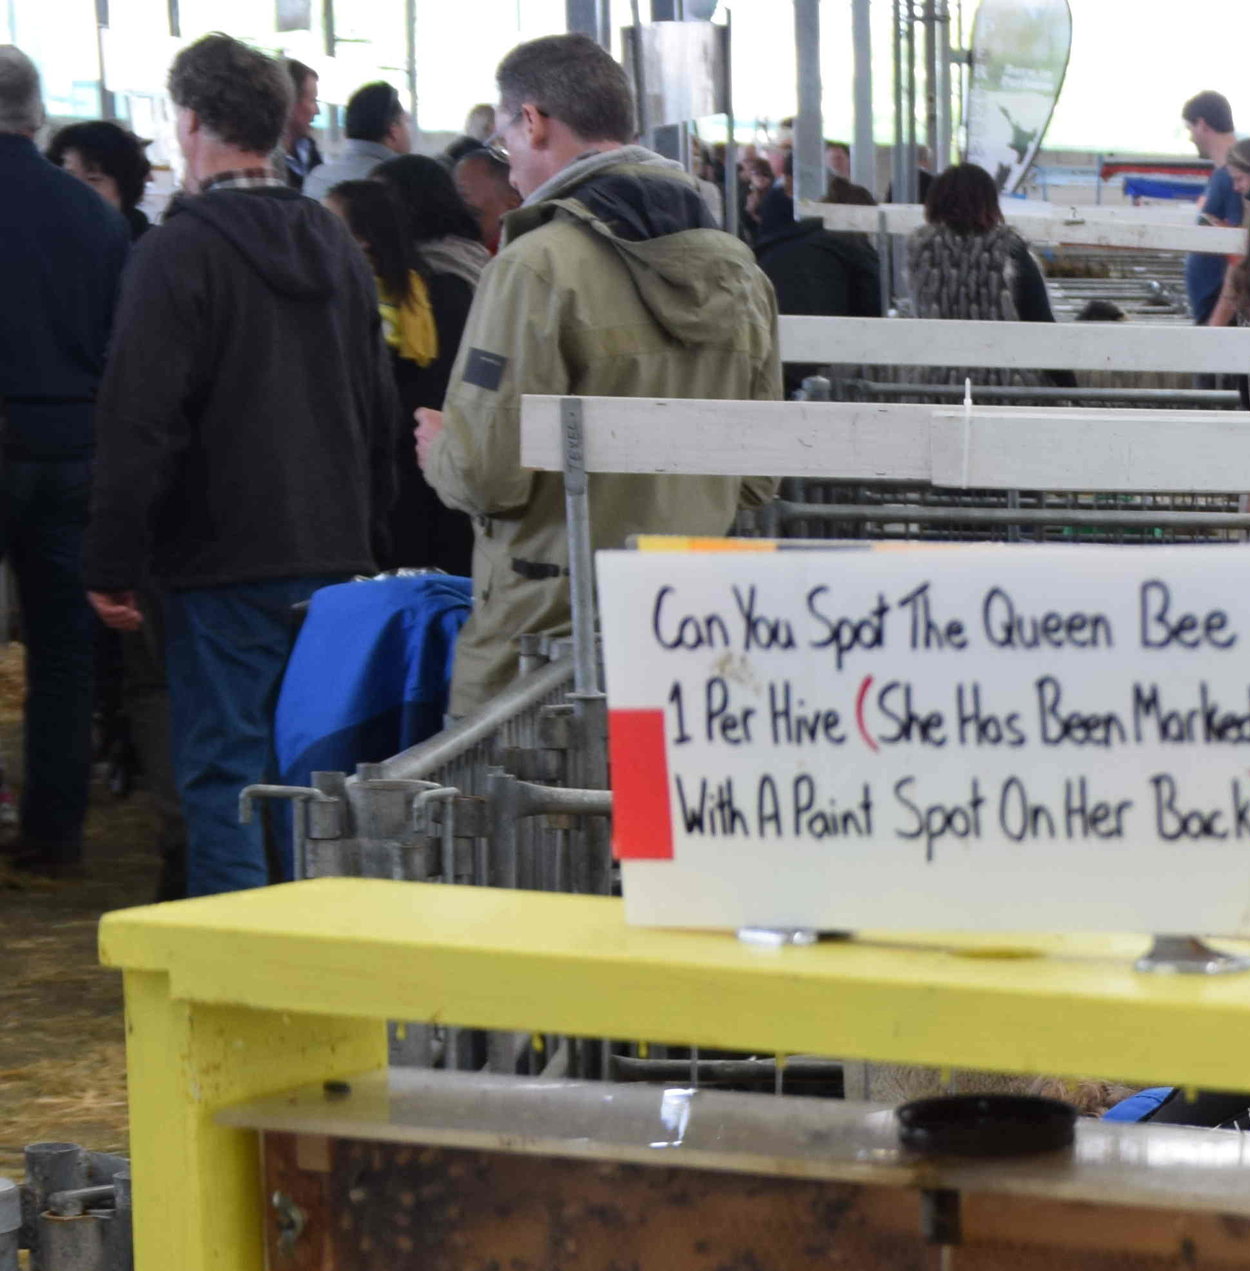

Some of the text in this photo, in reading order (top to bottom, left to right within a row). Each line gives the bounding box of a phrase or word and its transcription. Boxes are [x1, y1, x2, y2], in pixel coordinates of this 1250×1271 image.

[653, 579, 1237, 671] Can You Spot The Queen Bee
[669, 681, 691, 744] 1
[706, 676, 757, 744] Per
[769, 680, 846, 746] Hive
[856, 674, 947, 752] (She
[957, 681, 1026, 747] Has
[1035, 674, 1127, 747] Been
[675, 773, 749, 838] With
[757, 773, 783, 838] A
[792, 773, 872, 839] Paint
[893, 775, 986, 862] Spot
[1000, 775, 1056, 842] On
[1064, 775, 1133, 839] Her
